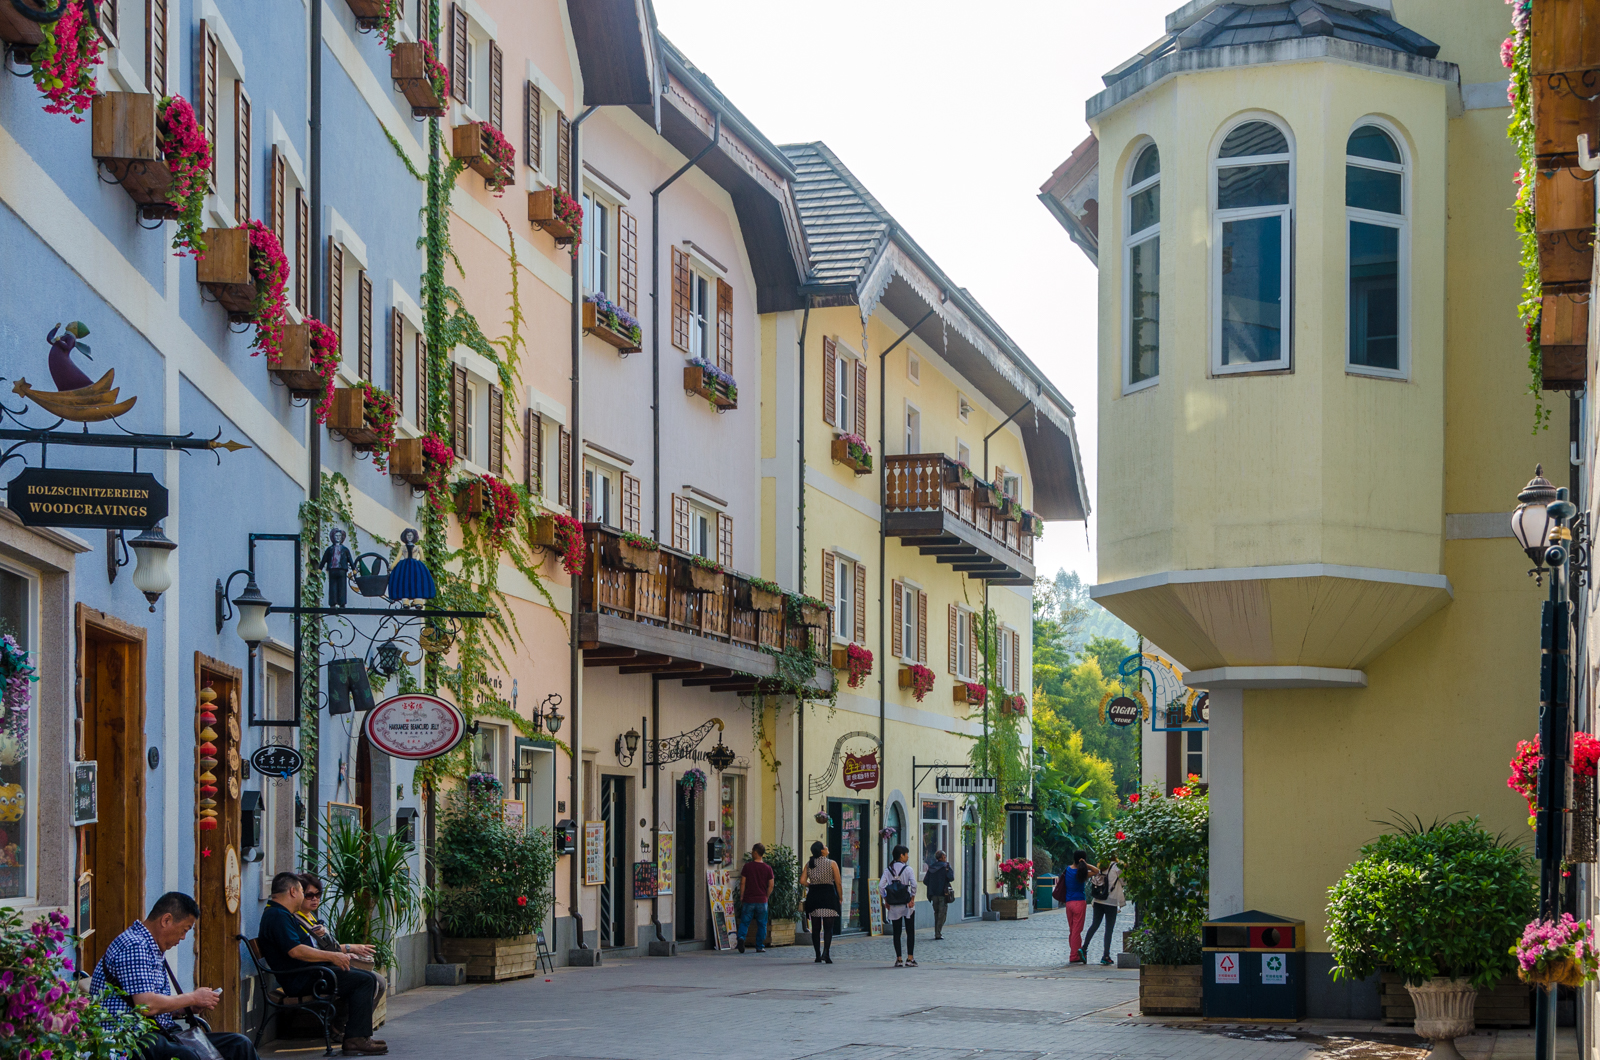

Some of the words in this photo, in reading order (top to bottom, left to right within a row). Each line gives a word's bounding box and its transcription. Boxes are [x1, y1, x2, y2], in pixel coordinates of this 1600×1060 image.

[27, 485, 149, 499] HOLZSCHNITZEREIEN
[29, 502, 148, 517] WOODCRAVINGS
[1110, 705, 1137, 715] CIGAR
